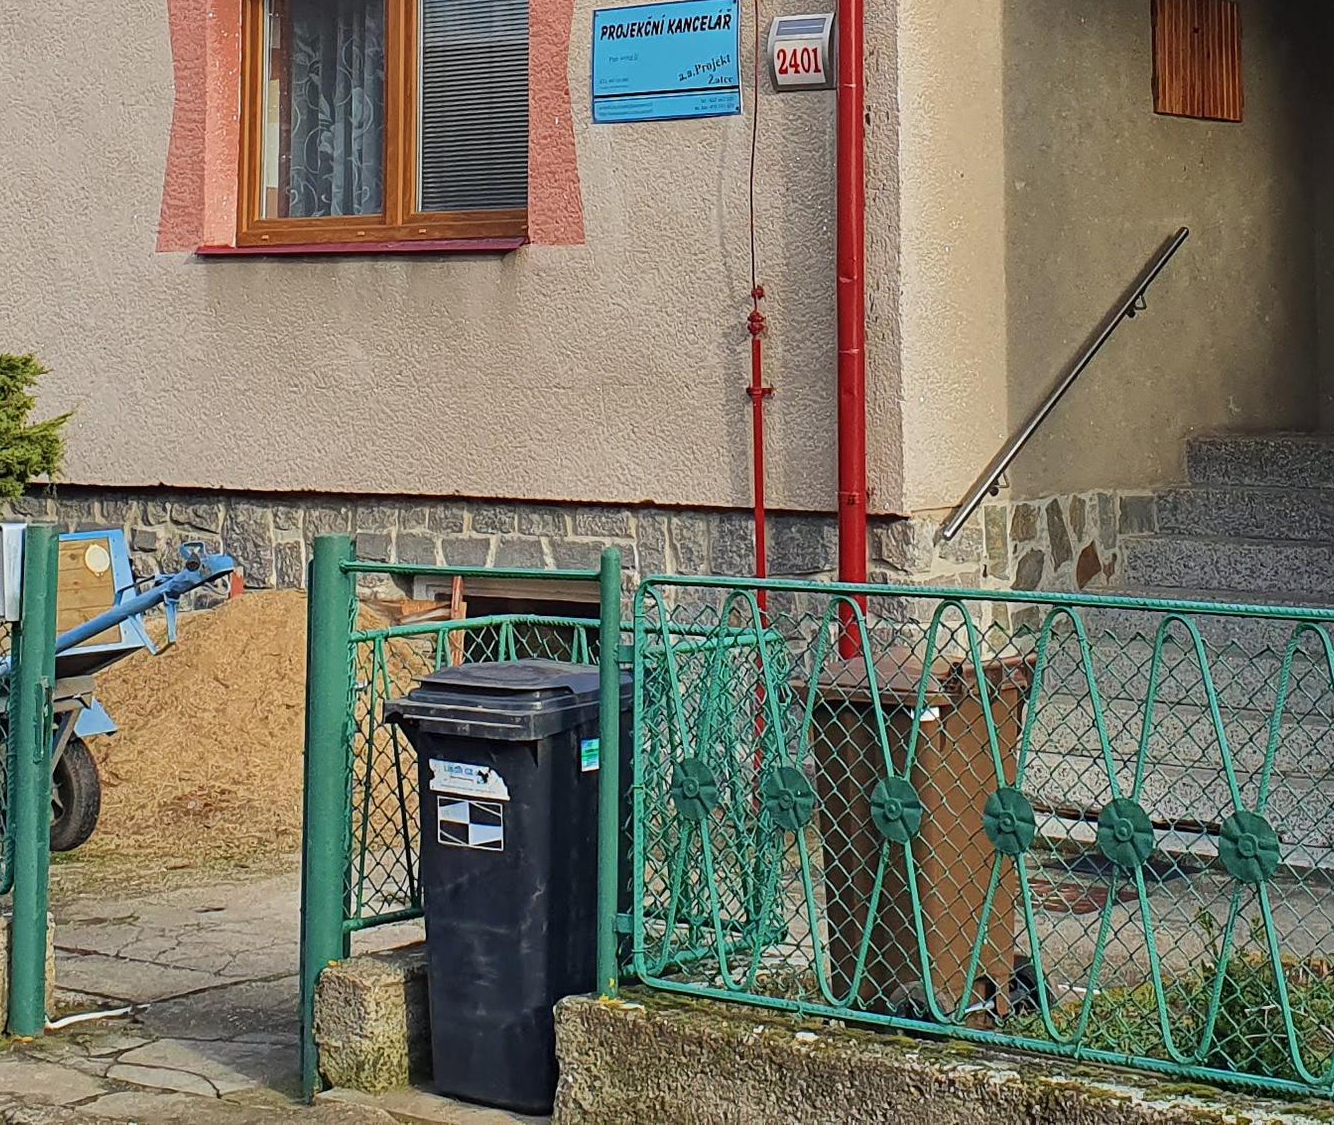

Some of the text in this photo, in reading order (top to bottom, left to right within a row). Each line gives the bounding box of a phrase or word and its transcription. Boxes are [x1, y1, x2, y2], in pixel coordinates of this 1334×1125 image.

[600, 8, 732, 41] PROJEKČNÍ KANCELÁŘ
[776, 47, 822, 75] 2401
